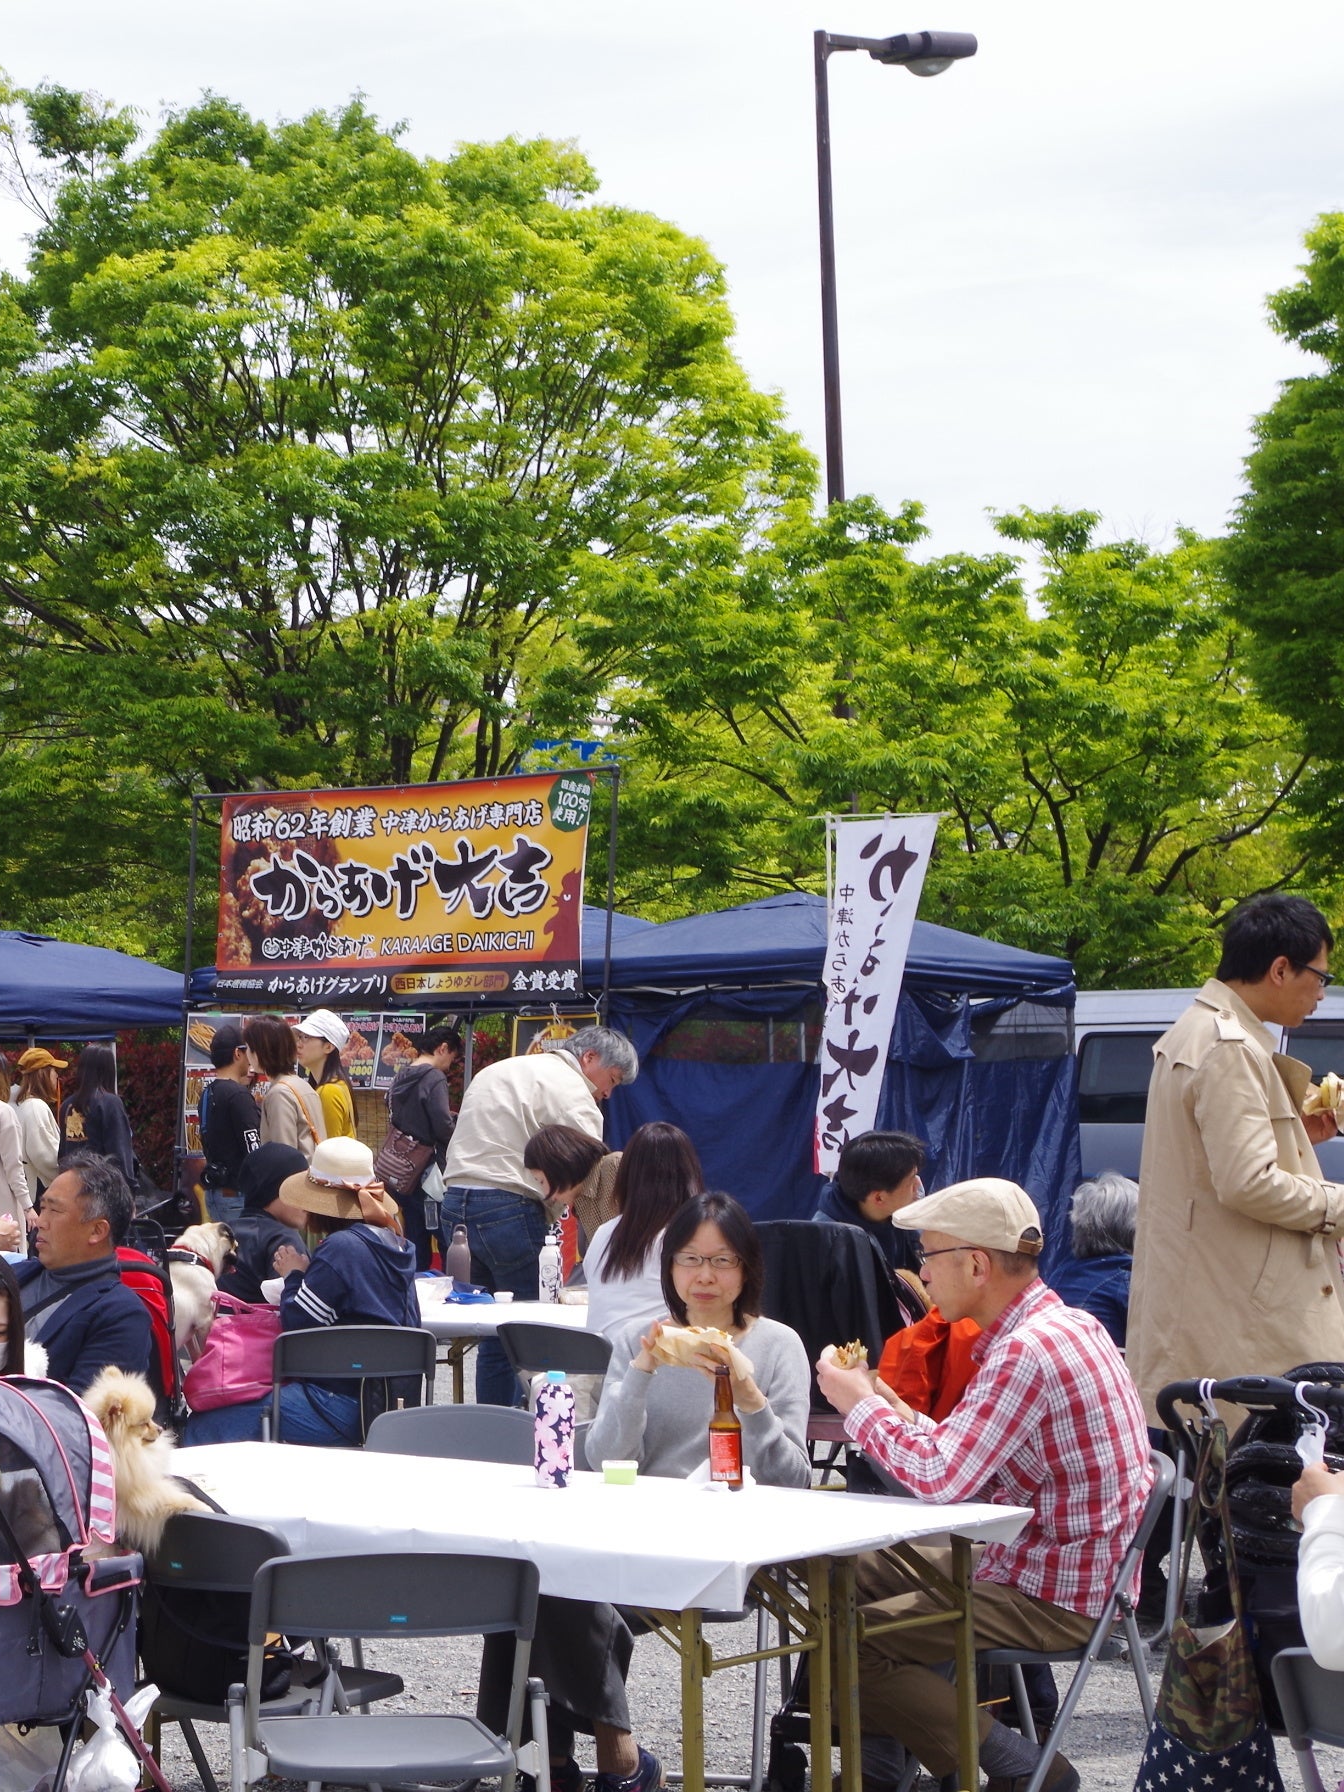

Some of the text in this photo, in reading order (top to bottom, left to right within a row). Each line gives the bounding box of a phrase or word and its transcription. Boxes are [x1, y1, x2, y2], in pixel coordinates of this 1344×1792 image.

[558, 790, 589, 812] 100%
[232, 799, 544, 843] 昭和62年創業 中津からあげ専門店
[250, 833, 553, 920] からあげ大吉
[380, 930, 535, 956] KARAAGE DAIKICHI
[267, 973, 387, 995] からあげグランプリ
[394, 974, 505, 990] 西日本しょうゆダレ部門
[512, 968, 579, 992] 金賞受賞
